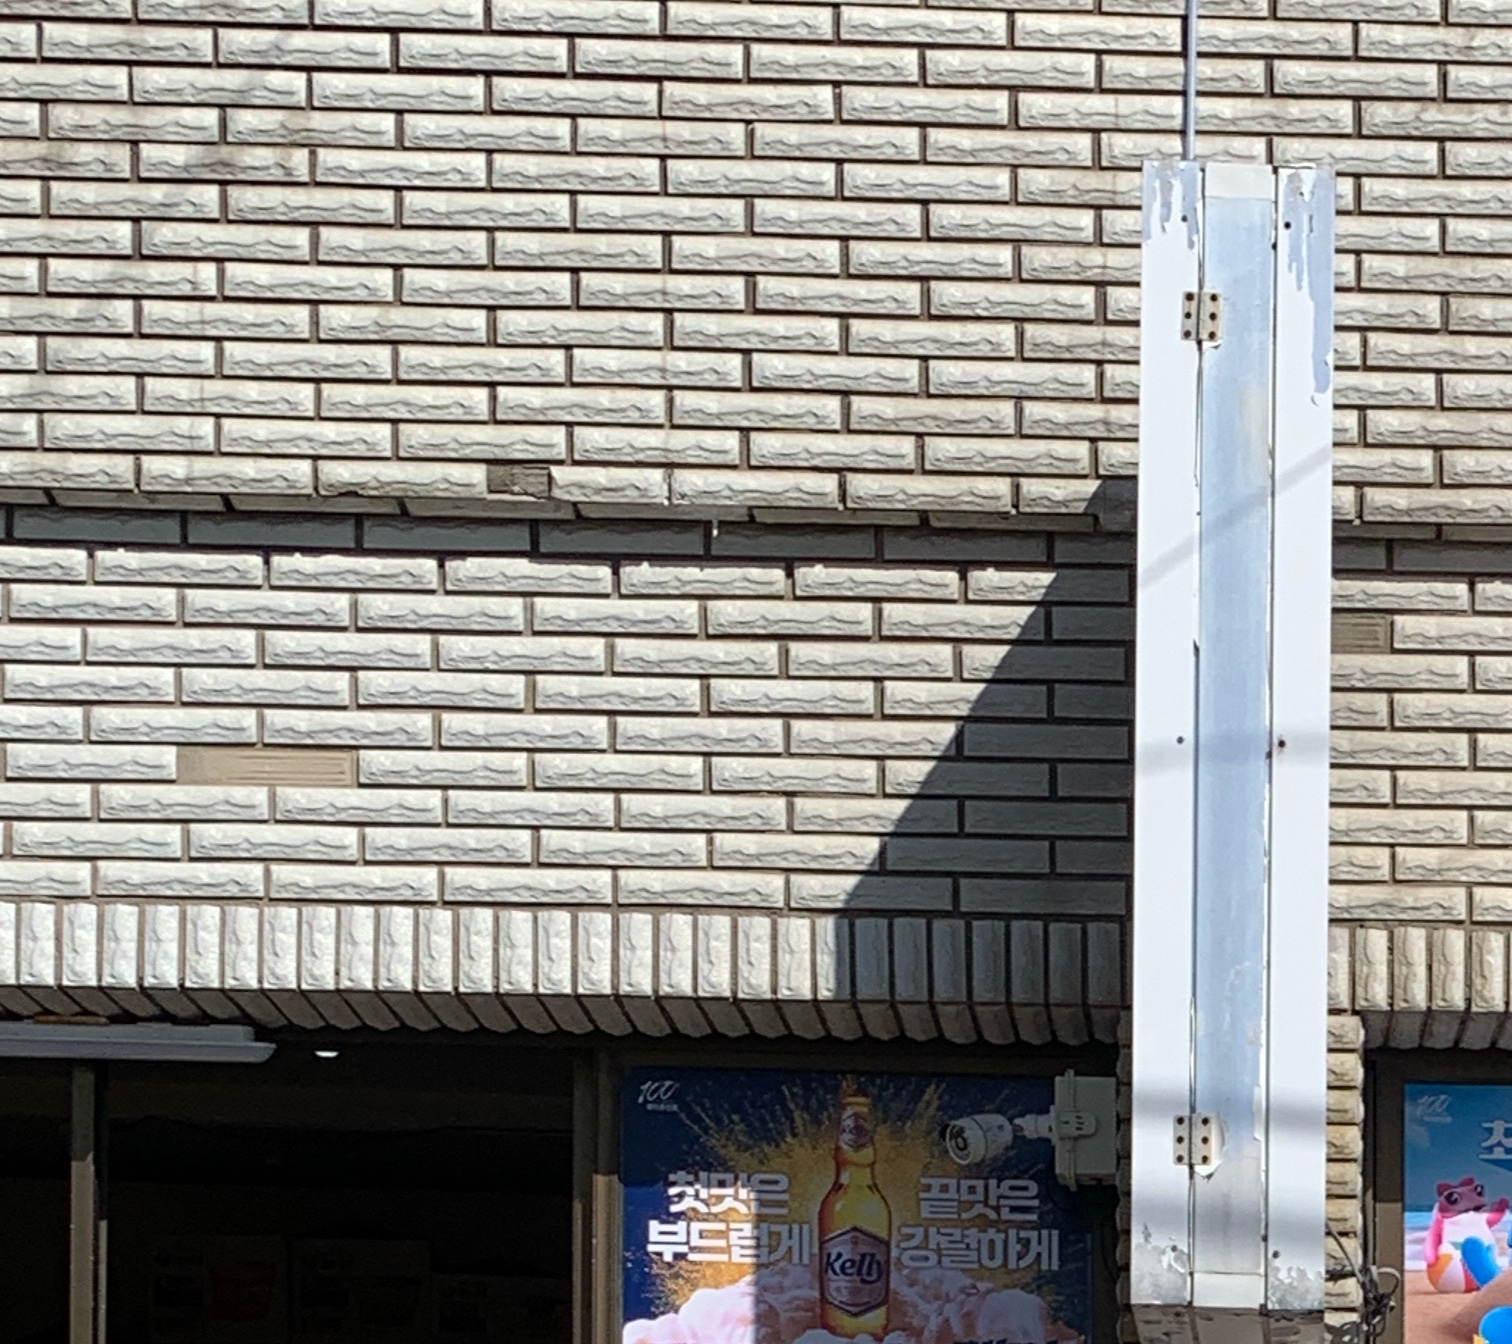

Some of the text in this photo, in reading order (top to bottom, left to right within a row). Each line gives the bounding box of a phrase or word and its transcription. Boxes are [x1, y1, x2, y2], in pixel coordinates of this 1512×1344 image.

[667, 1170, 1041, 1221] 첫맛은 끝맛은
[647, 1218, 1060, 1271] 부드럽게 강렬하게
[824, 1250, 884, 1284] Kelly
